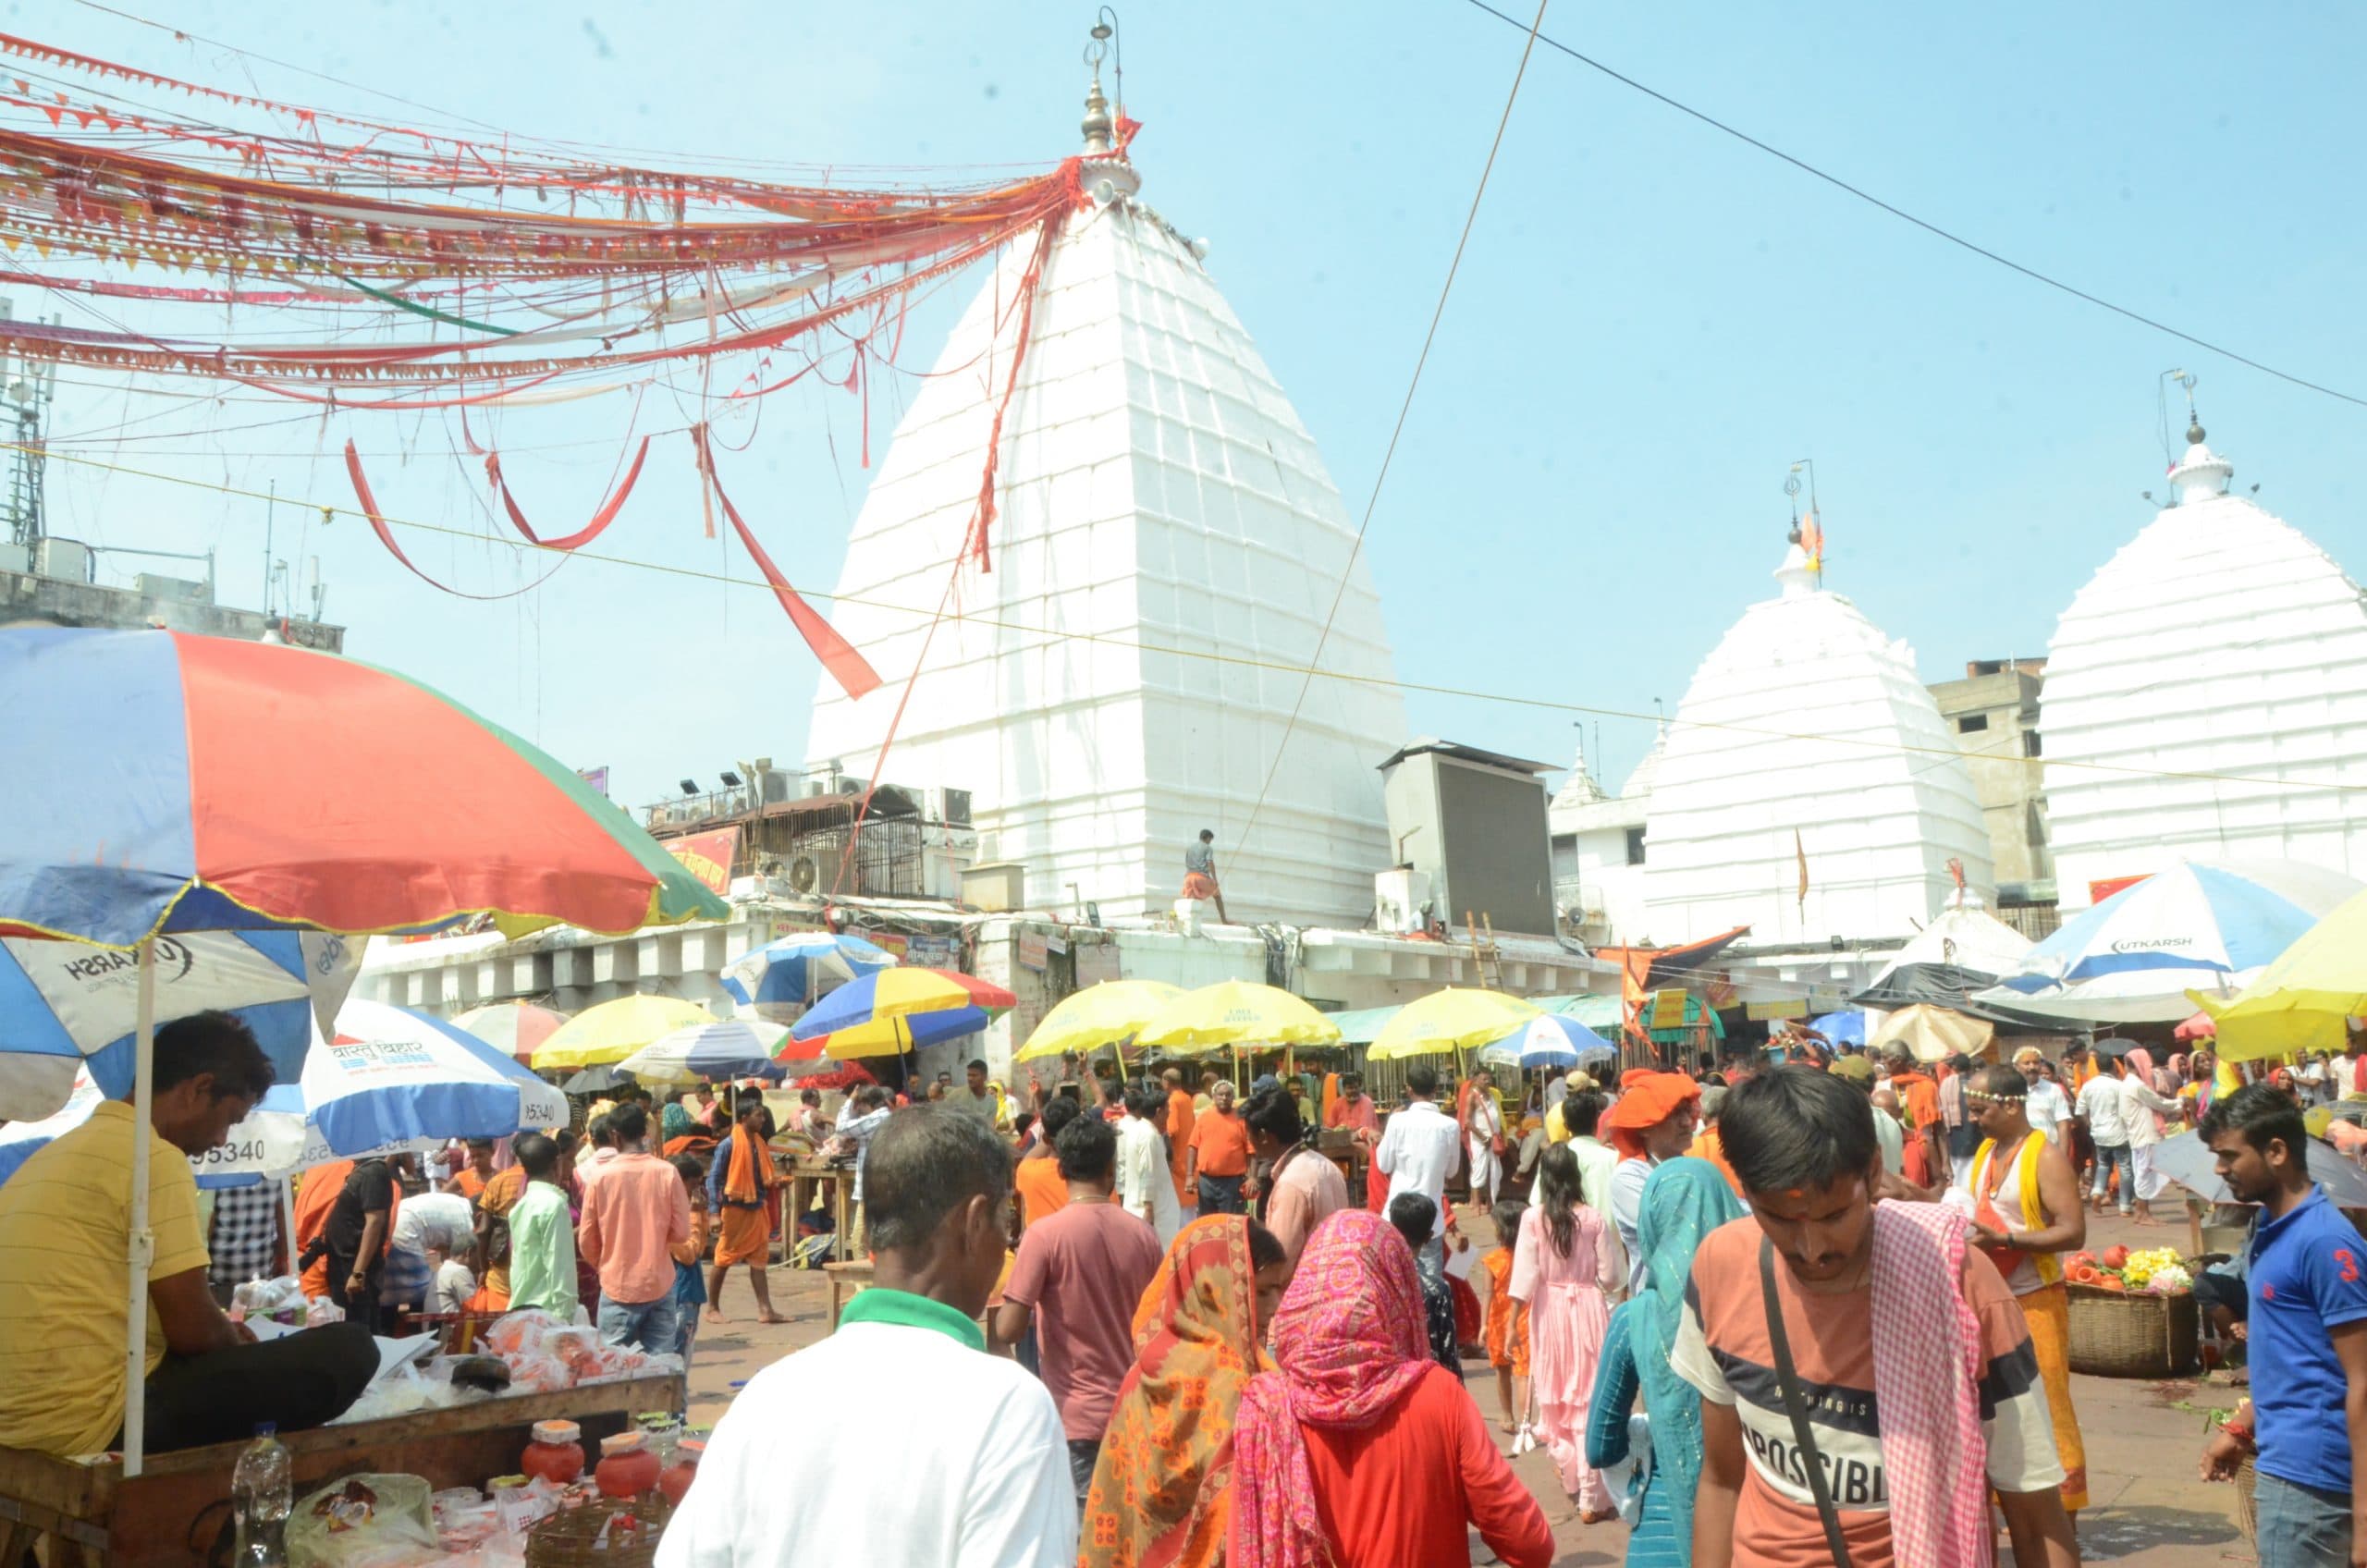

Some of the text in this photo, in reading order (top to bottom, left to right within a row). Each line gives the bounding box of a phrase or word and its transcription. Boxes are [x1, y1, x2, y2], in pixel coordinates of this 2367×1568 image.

[2119, 937, 2193, 950] UTKARSH
[331, 1038, 423, 1060] वास्तु विहार
[2333, 1248, 2360, 1283] 3
[1774, 1384, 1867, 1416] NHING IS
